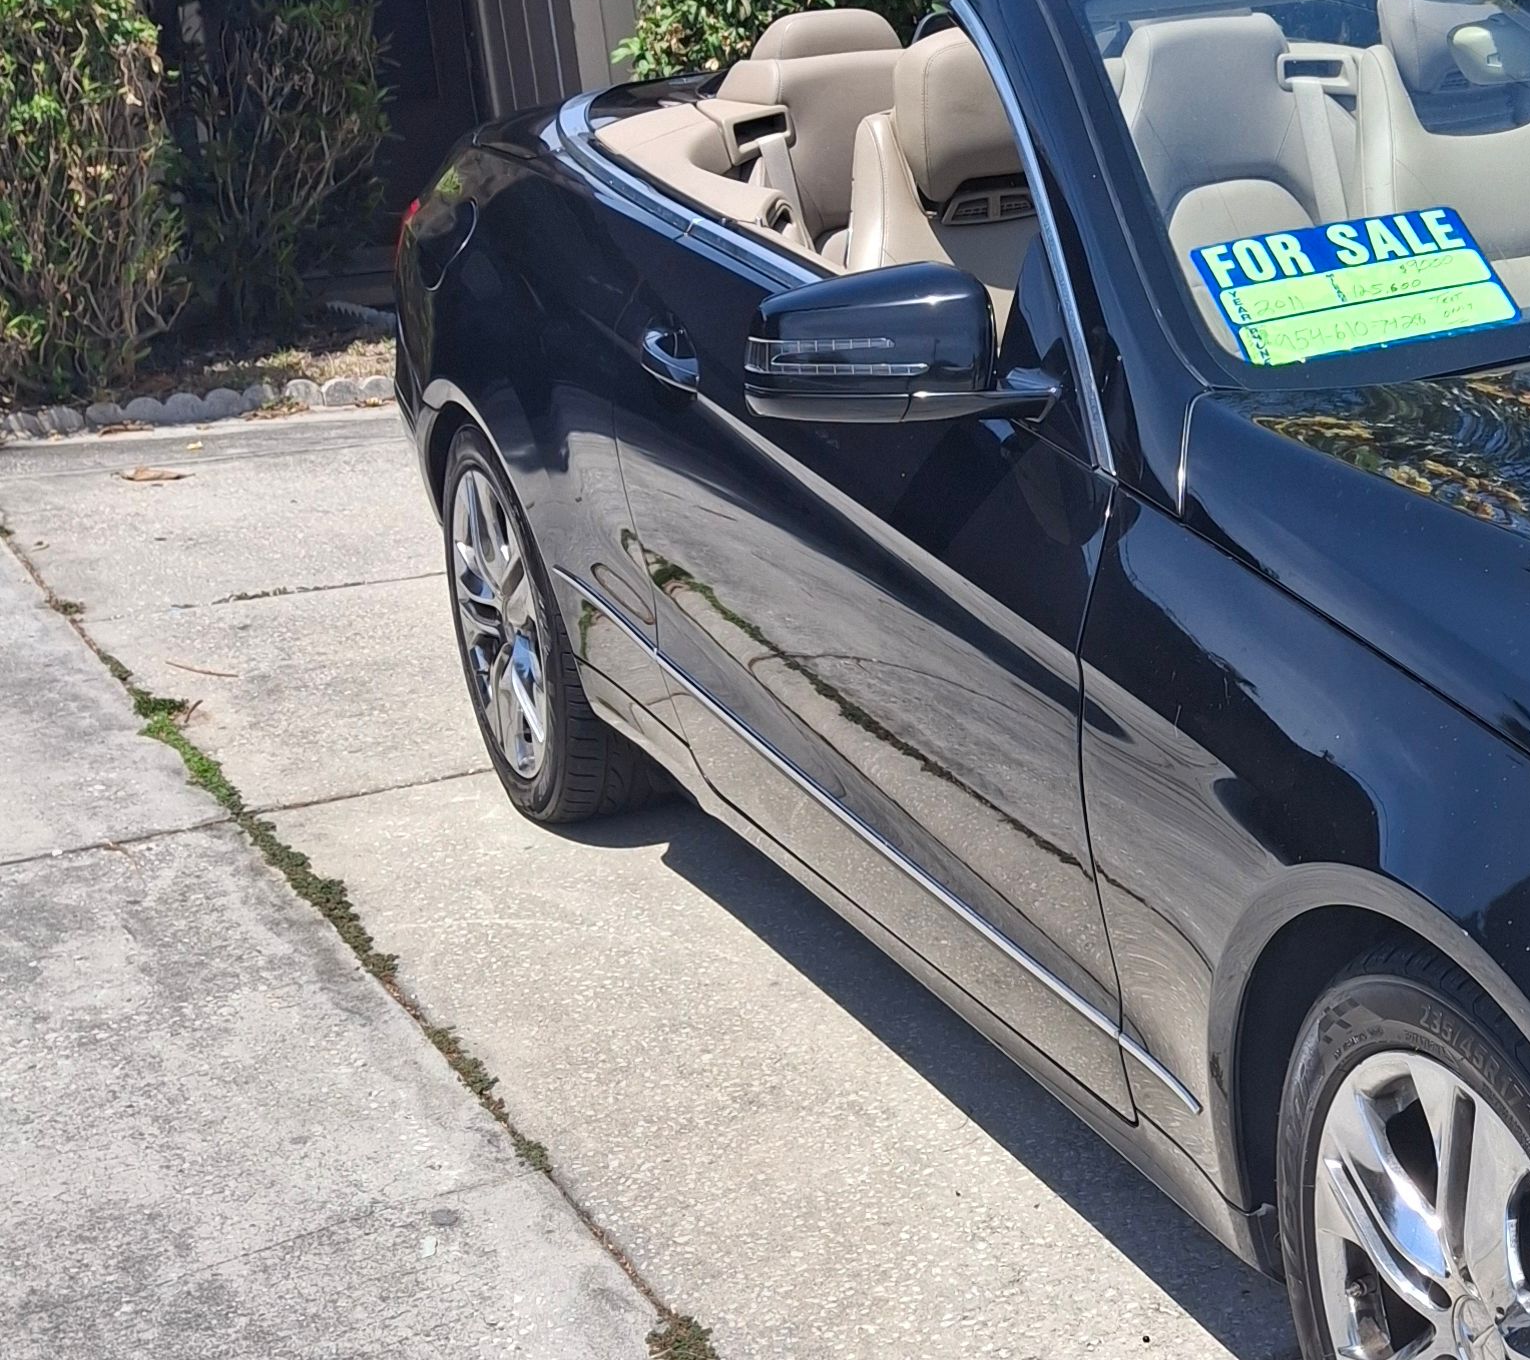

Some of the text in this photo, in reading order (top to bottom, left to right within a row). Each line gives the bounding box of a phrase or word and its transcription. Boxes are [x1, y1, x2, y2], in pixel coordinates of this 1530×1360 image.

[1200, 233, 1316, 289] FOR
[1325, 208, 1467, 267] SALE
[1227, 290, 1252, 322] YEAR
[1254, 295, 1305, 317] 2011
